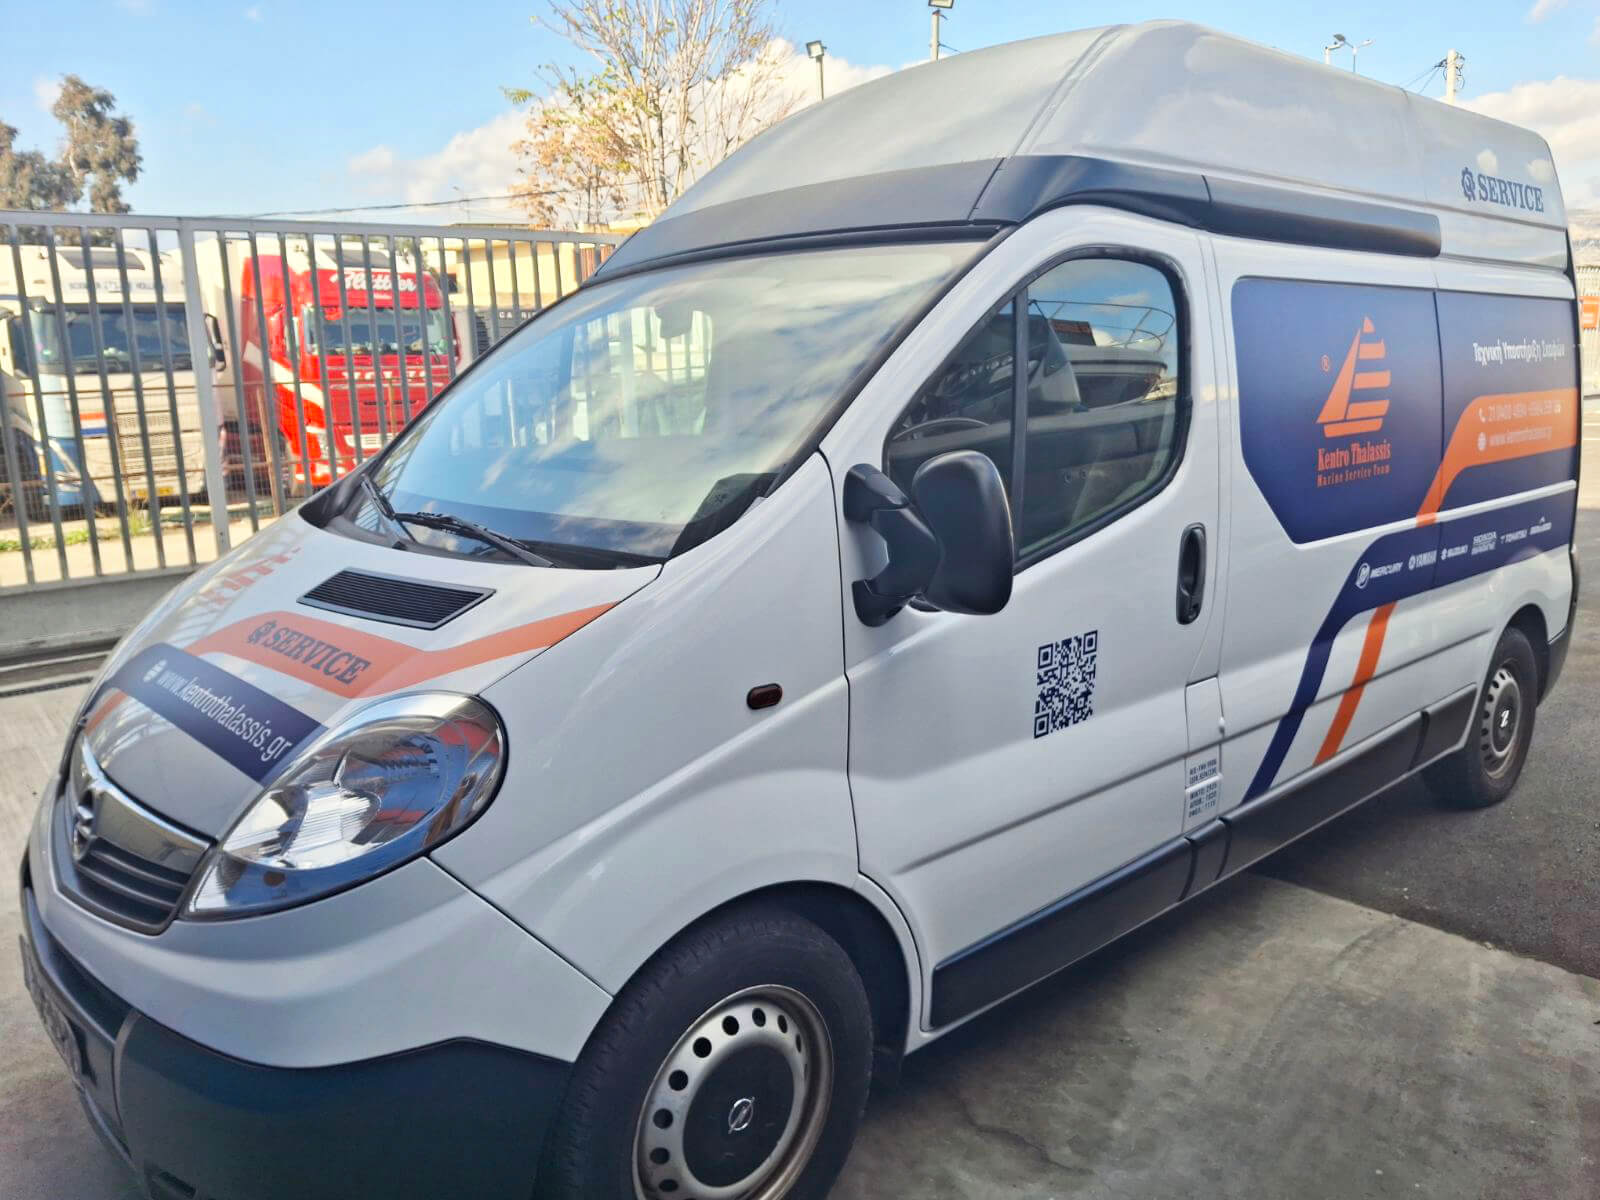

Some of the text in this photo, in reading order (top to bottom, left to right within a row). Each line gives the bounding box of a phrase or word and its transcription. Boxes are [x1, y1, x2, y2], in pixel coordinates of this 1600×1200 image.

[1477, 174, 1544, 212] SERVICE
[1318, 439, 1391, 471] Kentro Thalassis
[1370, 562, 1403, 578] MERCURY
[263, 627, 371, 684] SERVICE
[156, 670, 293, 762] www.kentrothalassis.gr
